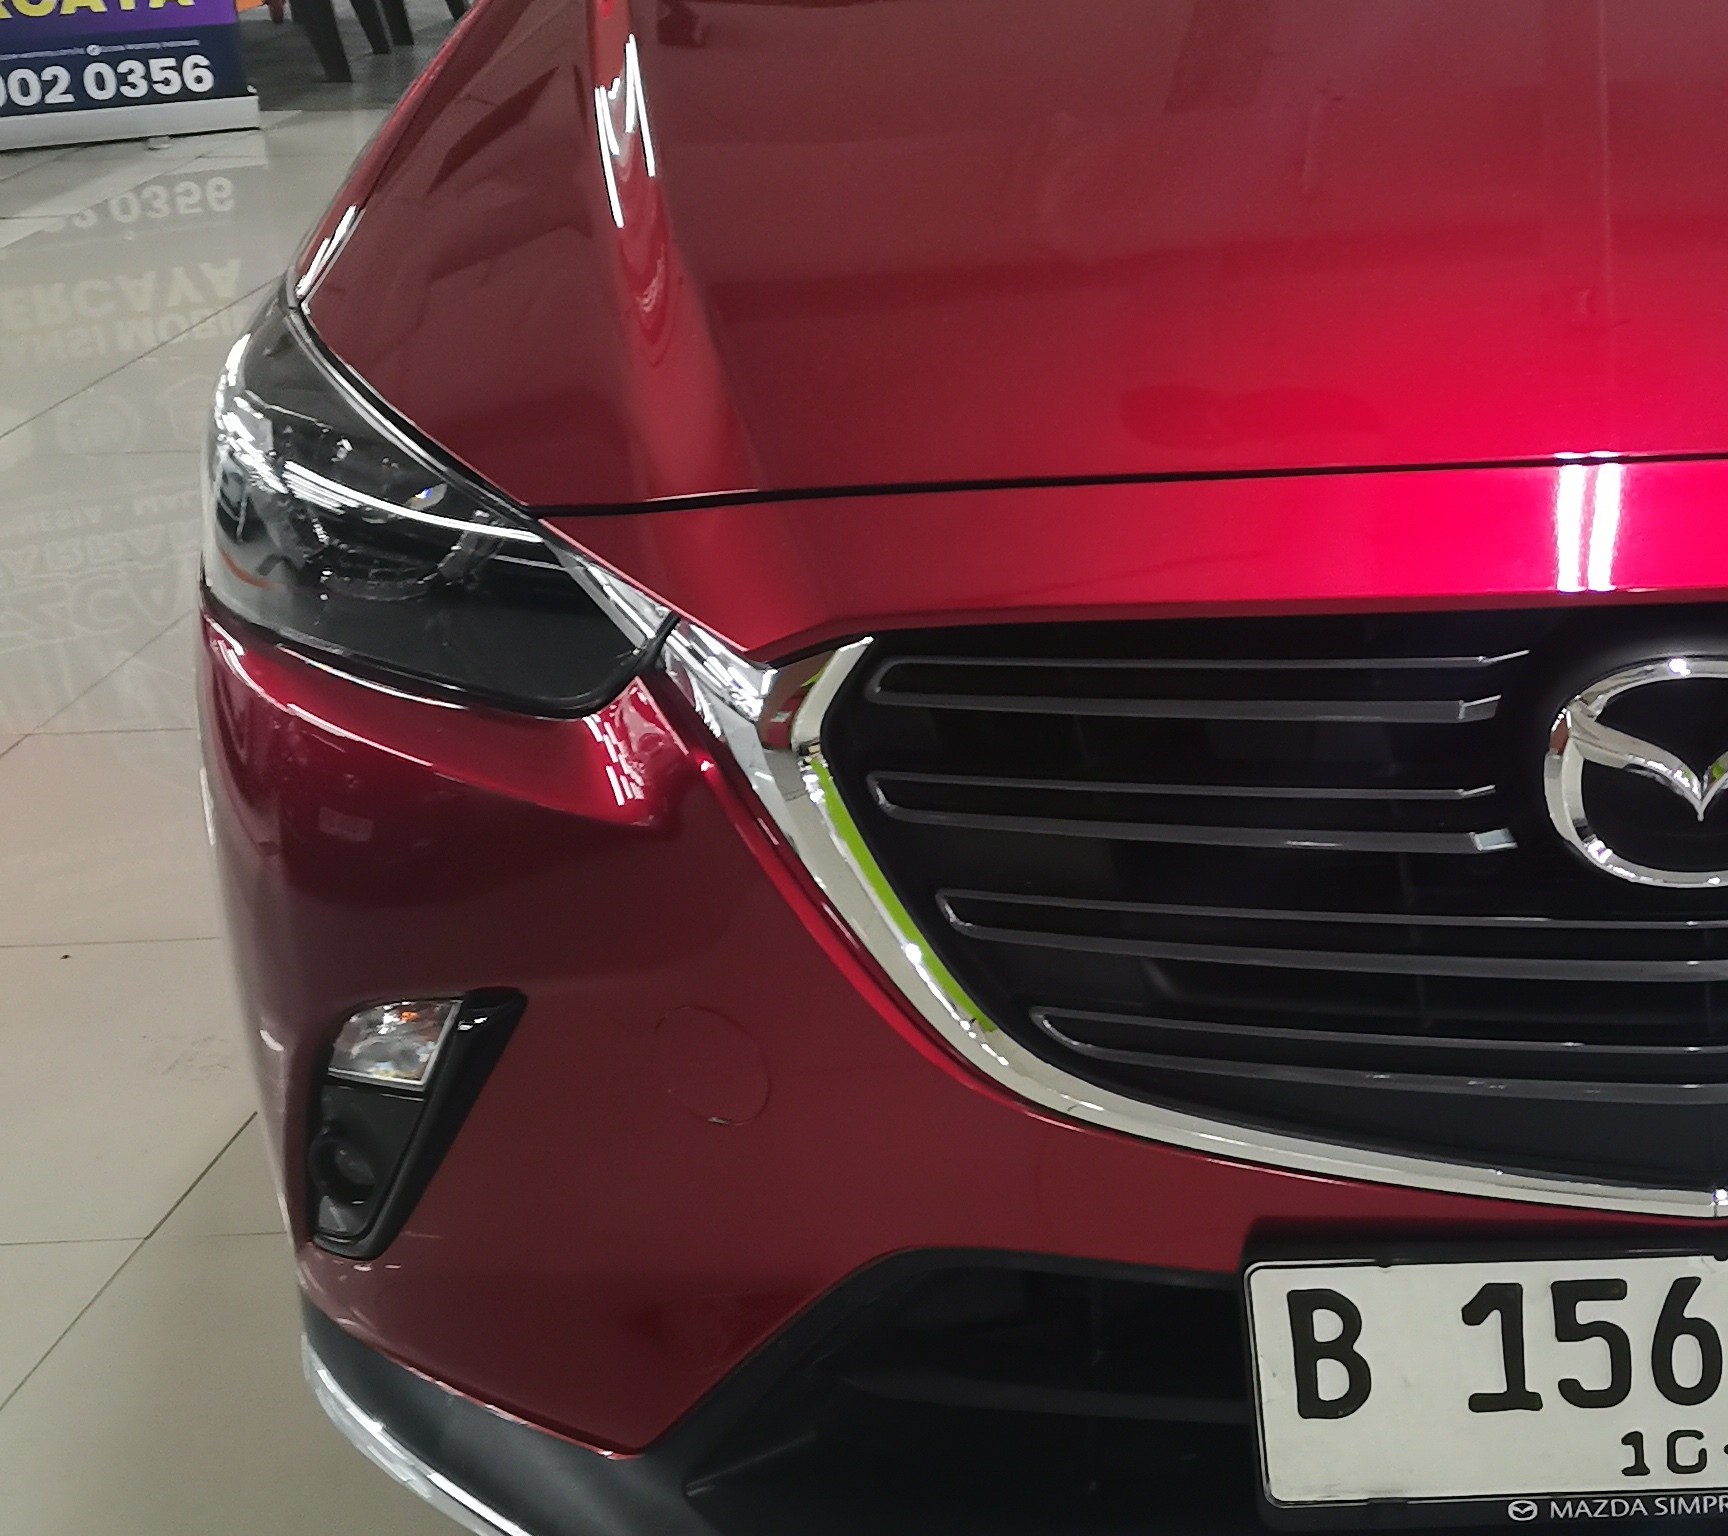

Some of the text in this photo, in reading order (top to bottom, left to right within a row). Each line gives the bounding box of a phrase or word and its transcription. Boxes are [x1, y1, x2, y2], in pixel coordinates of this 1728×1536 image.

[0, 54, 215, 109] 02 0356
[1286, 1288, 1372, 1419] B
[1549, 1498, 1649, 1520] MAZDA
